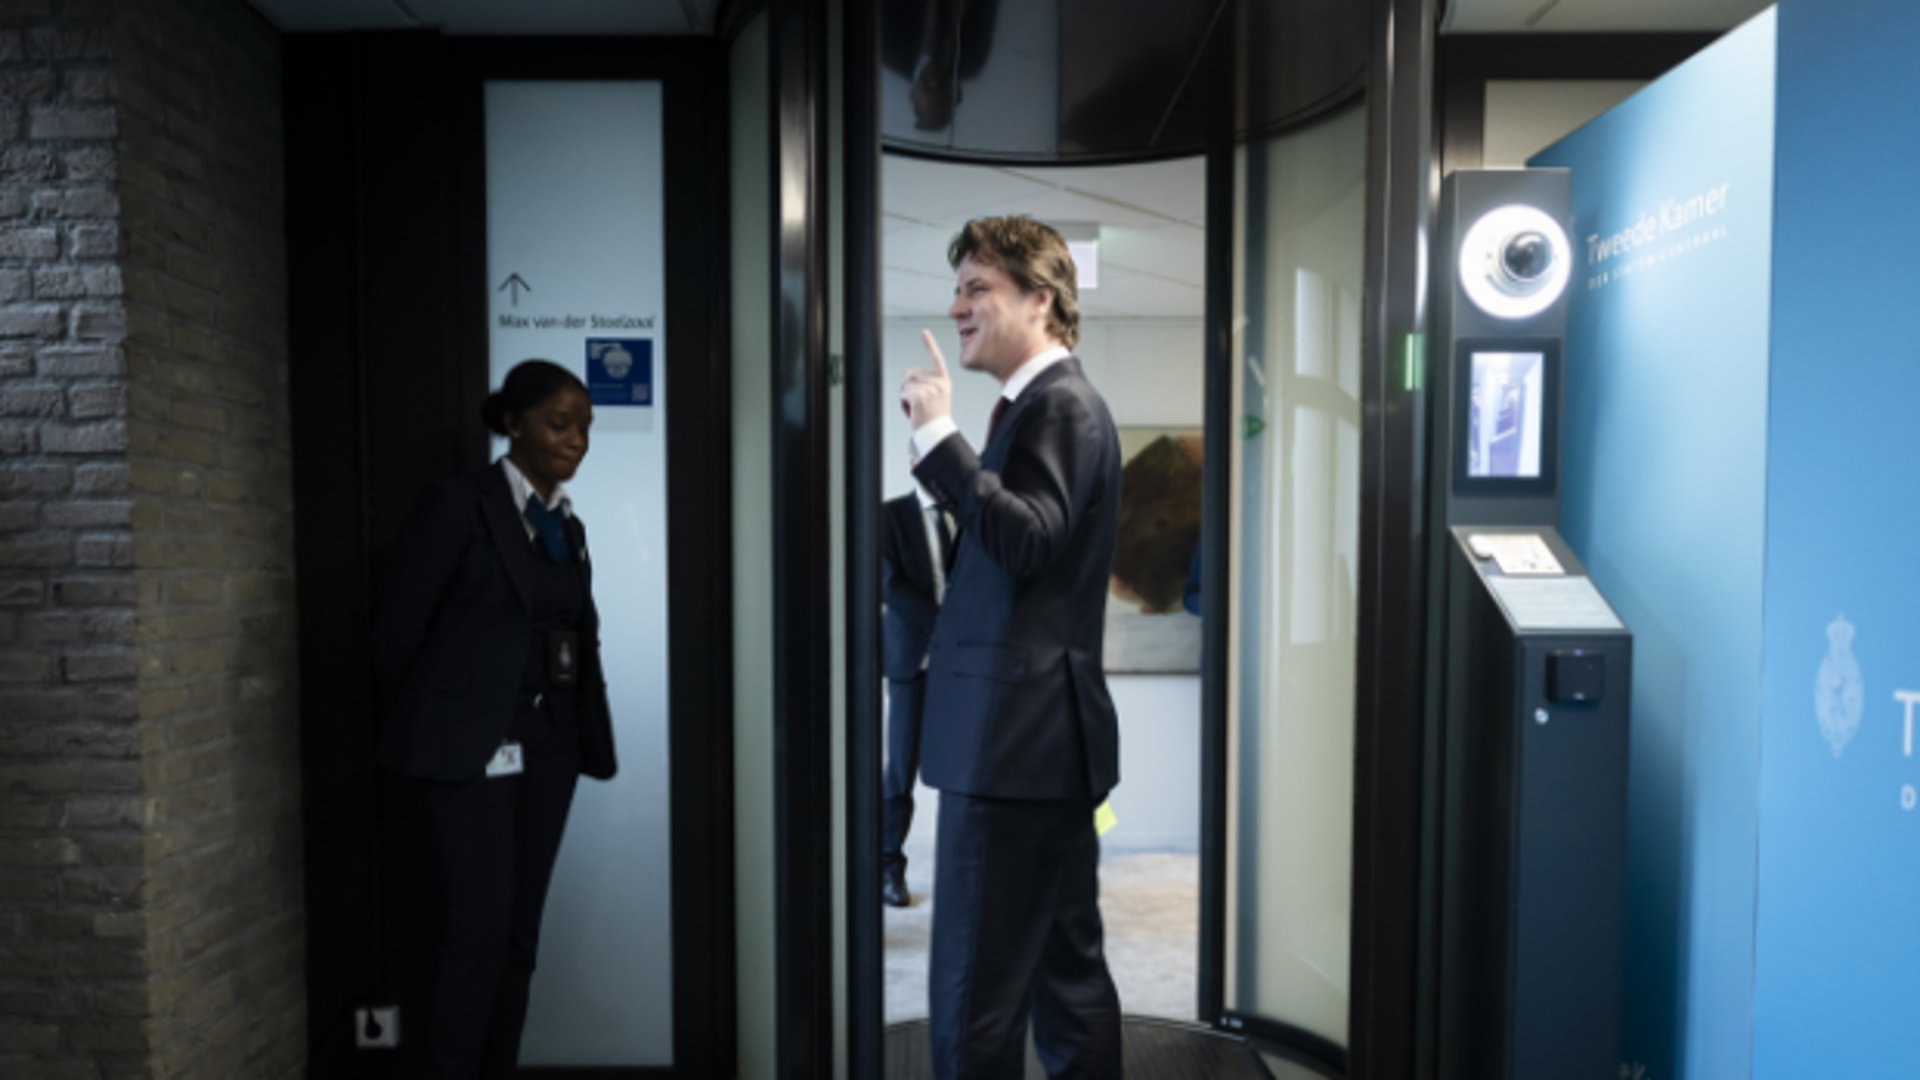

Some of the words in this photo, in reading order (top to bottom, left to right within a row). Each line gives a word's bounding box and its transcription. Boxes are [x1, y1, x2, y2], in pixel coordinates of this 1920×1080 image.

[1586, 211, 1656, 266] Tweede
[1659, 182, 1730, 236] Kamer
[499, 315, 528, 329] Max
[563, 314, 585, 329] der
